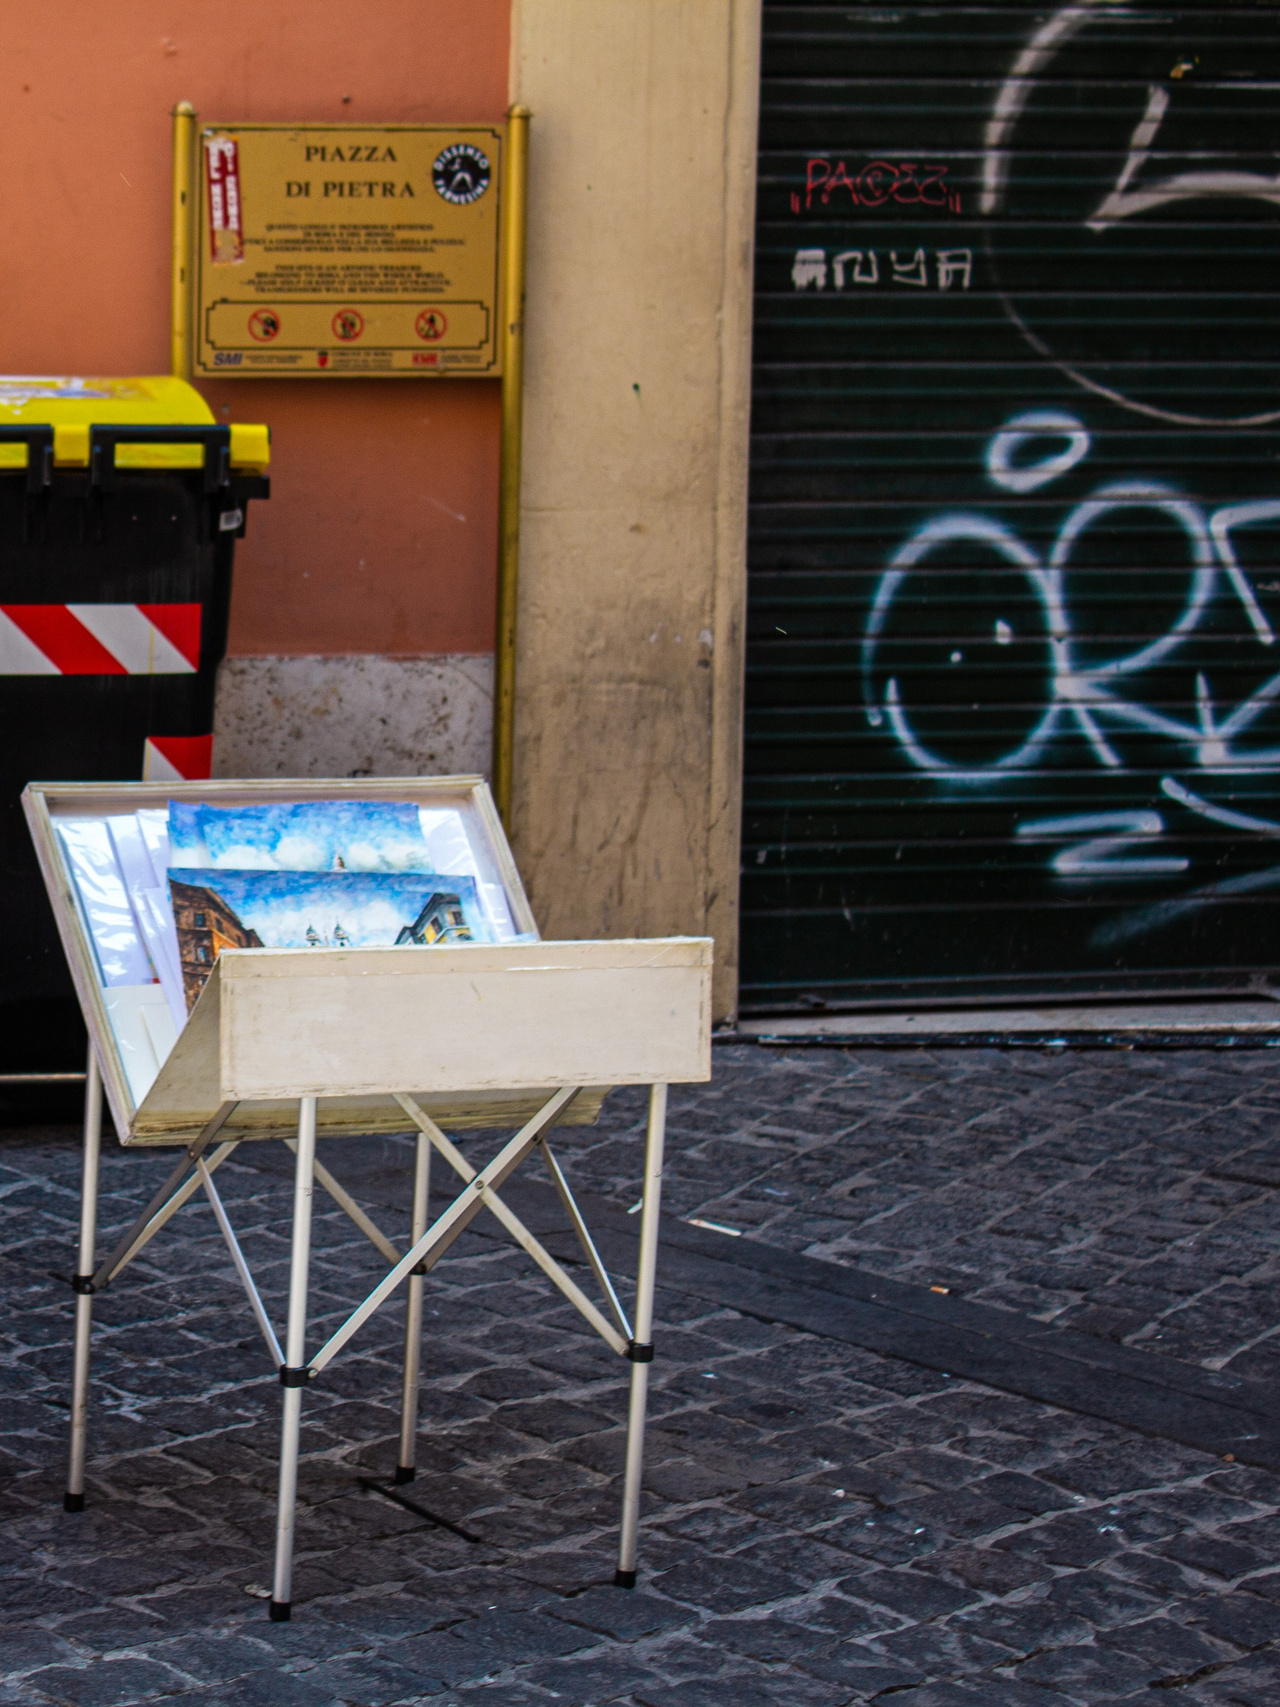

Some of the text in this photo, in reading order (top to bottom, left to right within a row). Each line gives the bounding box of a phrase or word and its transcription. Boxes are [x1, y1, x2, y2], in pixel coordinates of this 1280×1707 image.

[305, 145, 397, 162] PIAZZA
[433, 143, 490, 172] DISSENSO
[286, 181, 415, 198] DI PIETRA
